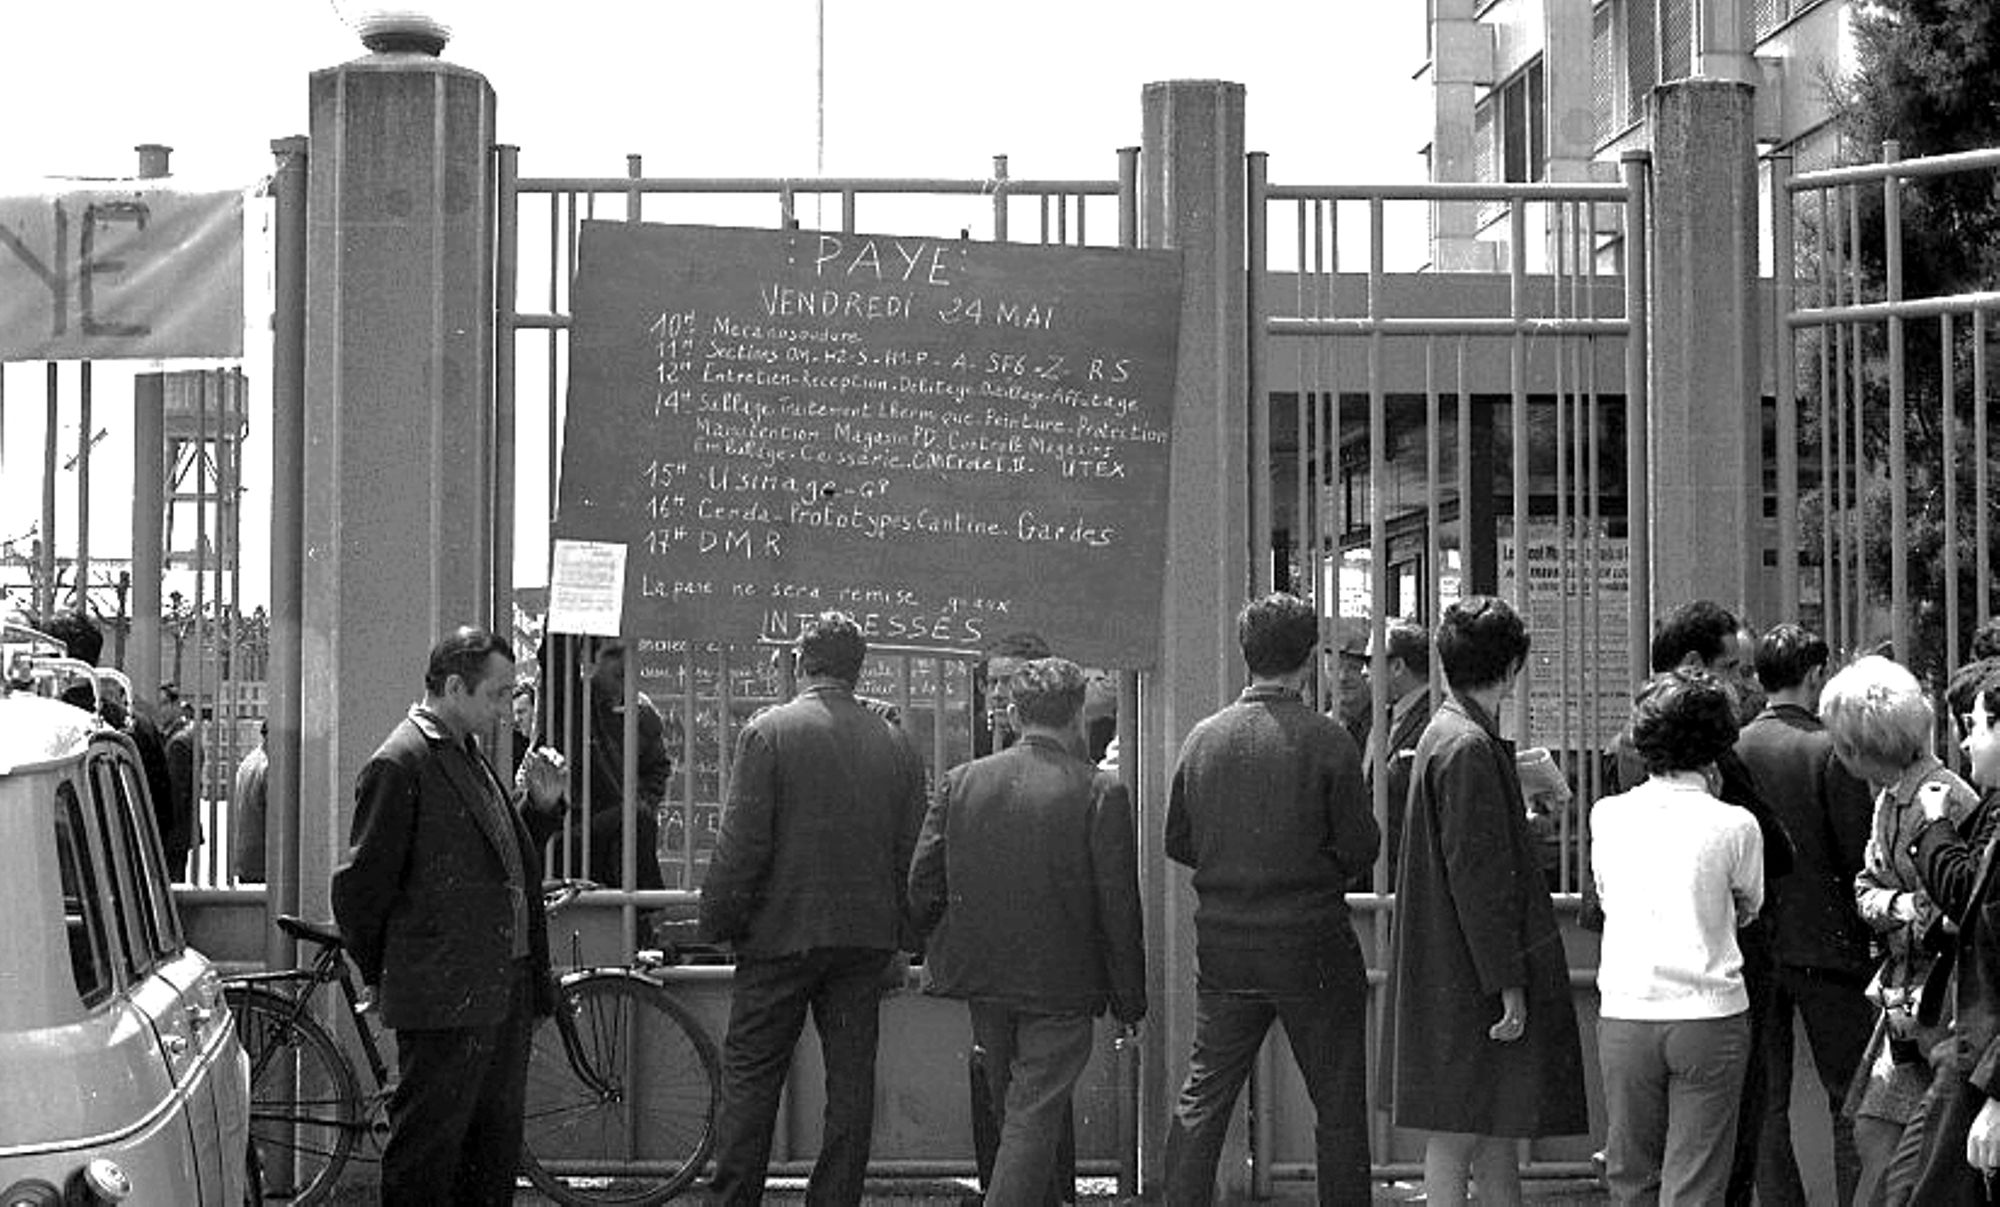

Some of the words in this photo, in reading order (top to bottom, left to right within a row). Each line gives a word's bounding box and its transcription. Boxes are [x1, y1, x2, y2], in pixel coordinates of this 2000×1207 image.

[938, 298, 982, 325] 24
[997, 302, 1053, 329] MAI
[1062, 460, 1125, 478] UTEX
[1018, 510, 1115, 546] Gardes
[733, 583, 756, 597] ne
[772, 581, 819, 599] sera
[838, 586, 919, 606] remise
